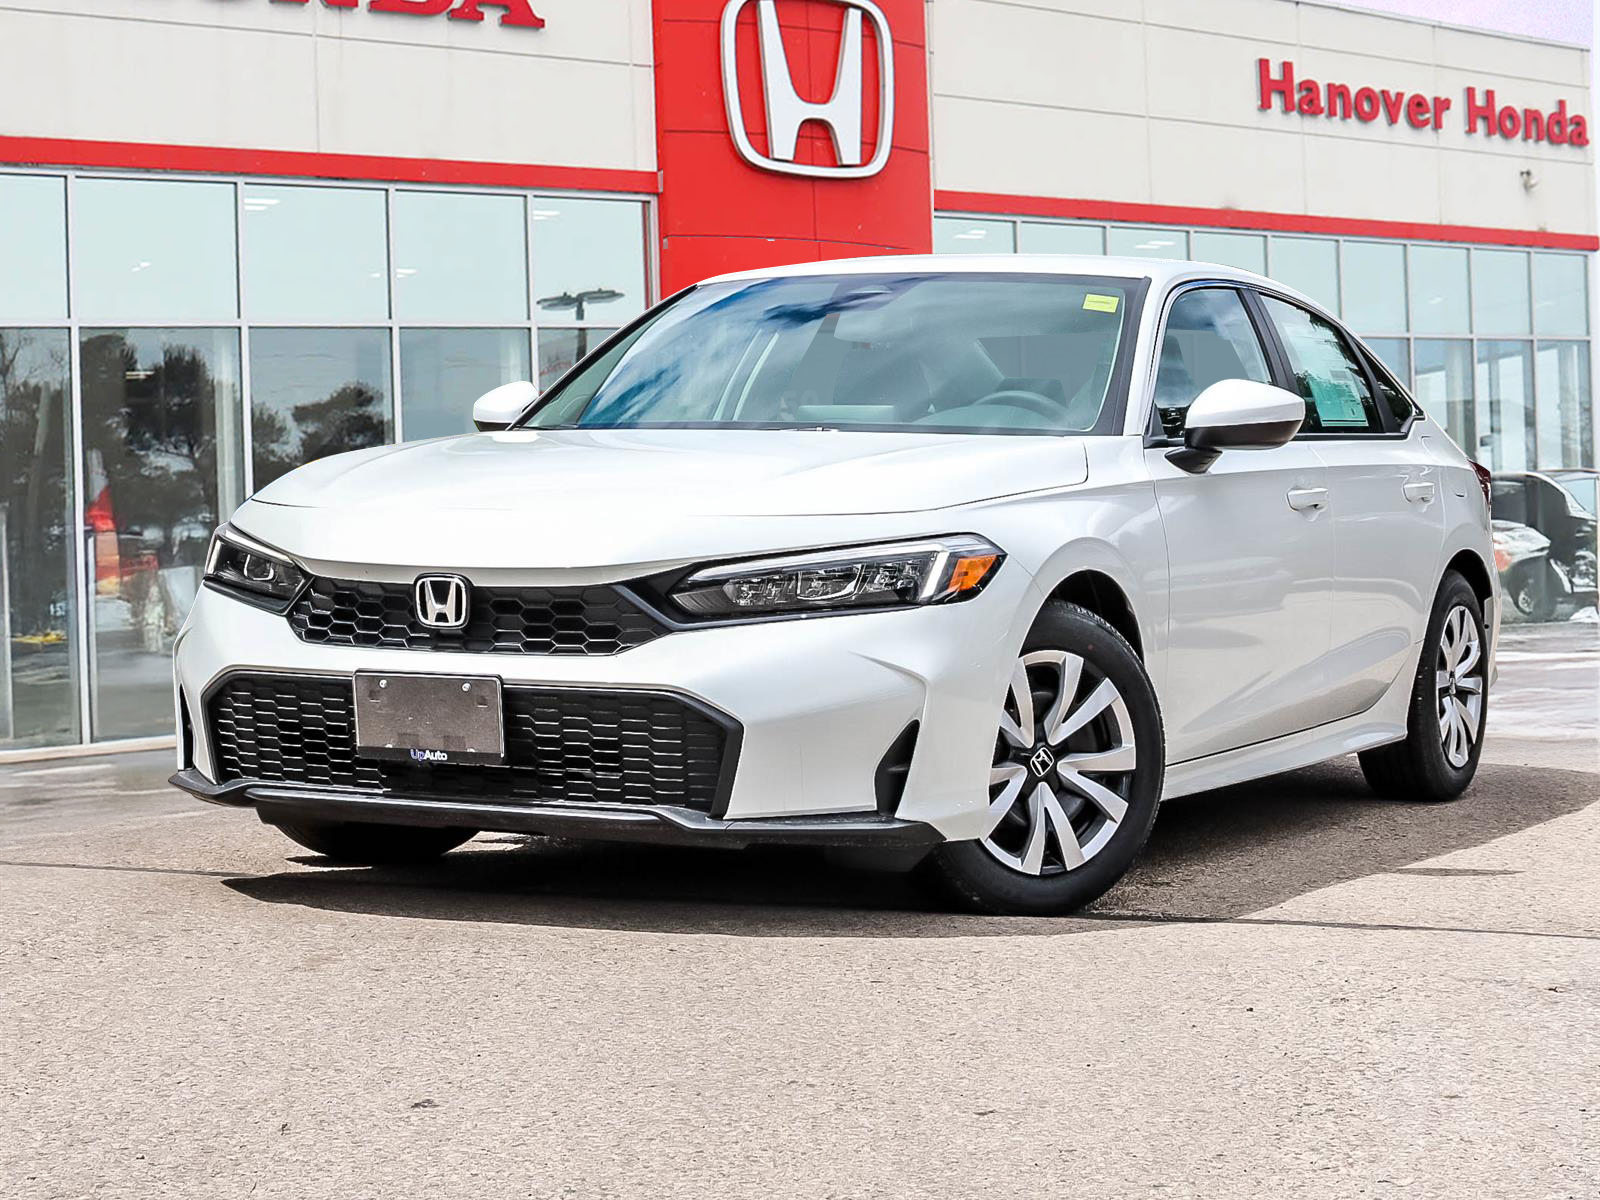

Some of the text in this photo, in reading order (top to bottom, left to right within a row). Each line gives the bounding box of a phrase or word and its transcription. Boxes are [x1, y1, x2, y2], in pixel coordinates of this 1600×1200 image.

[1258, 58, 1589, 146] Hanover Honda
[410, 748, 448, 762] UpAuto
